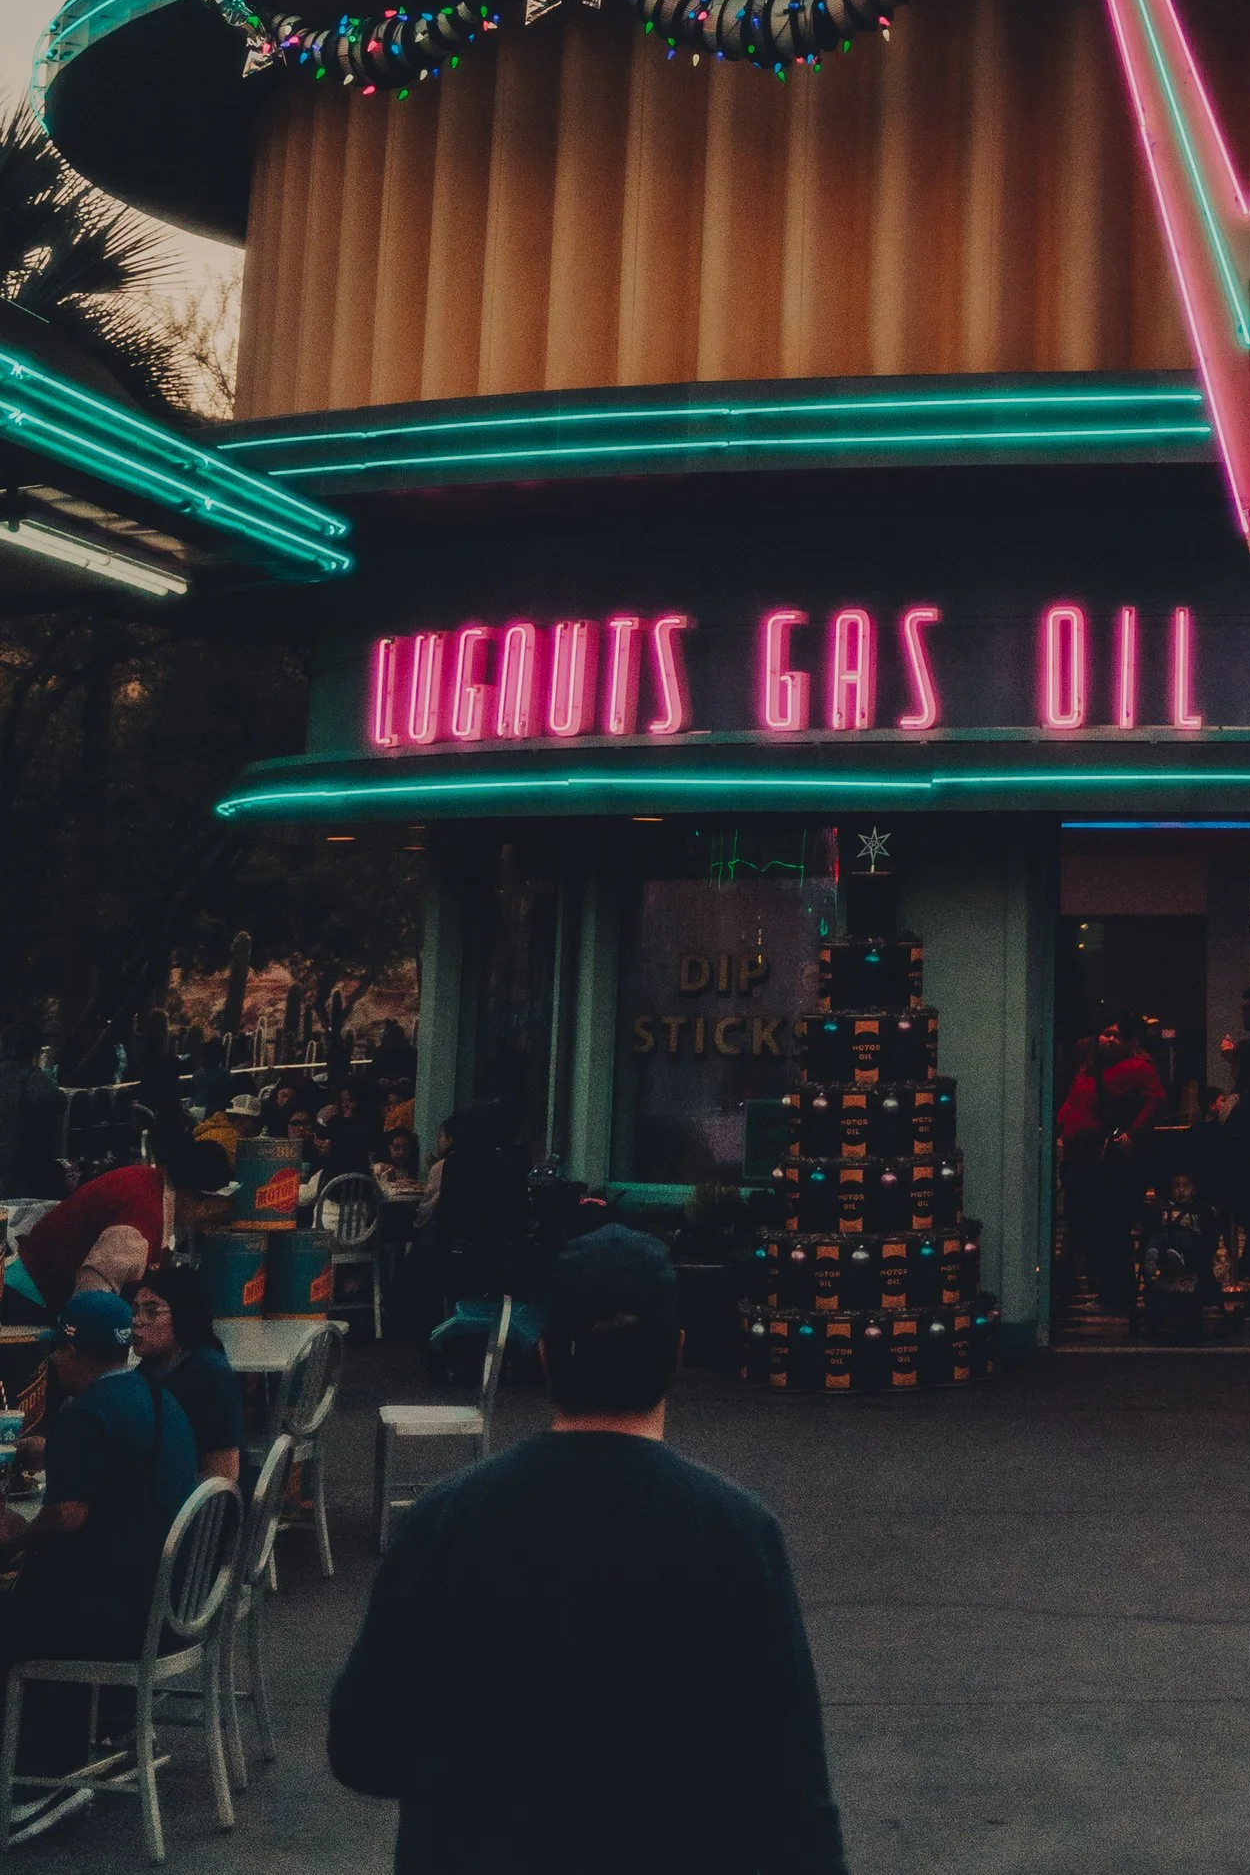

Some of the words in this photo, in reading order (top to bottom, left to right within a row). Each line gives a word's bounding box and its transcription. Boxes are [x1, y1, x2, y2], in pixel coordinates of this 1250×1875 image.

[374, 615, 688, 746] LUGNUTS
[764, 606, 942, 731] GAS
[1045, 605, 1202, 730] OIL
[679, 953, 771, 994] DIP
